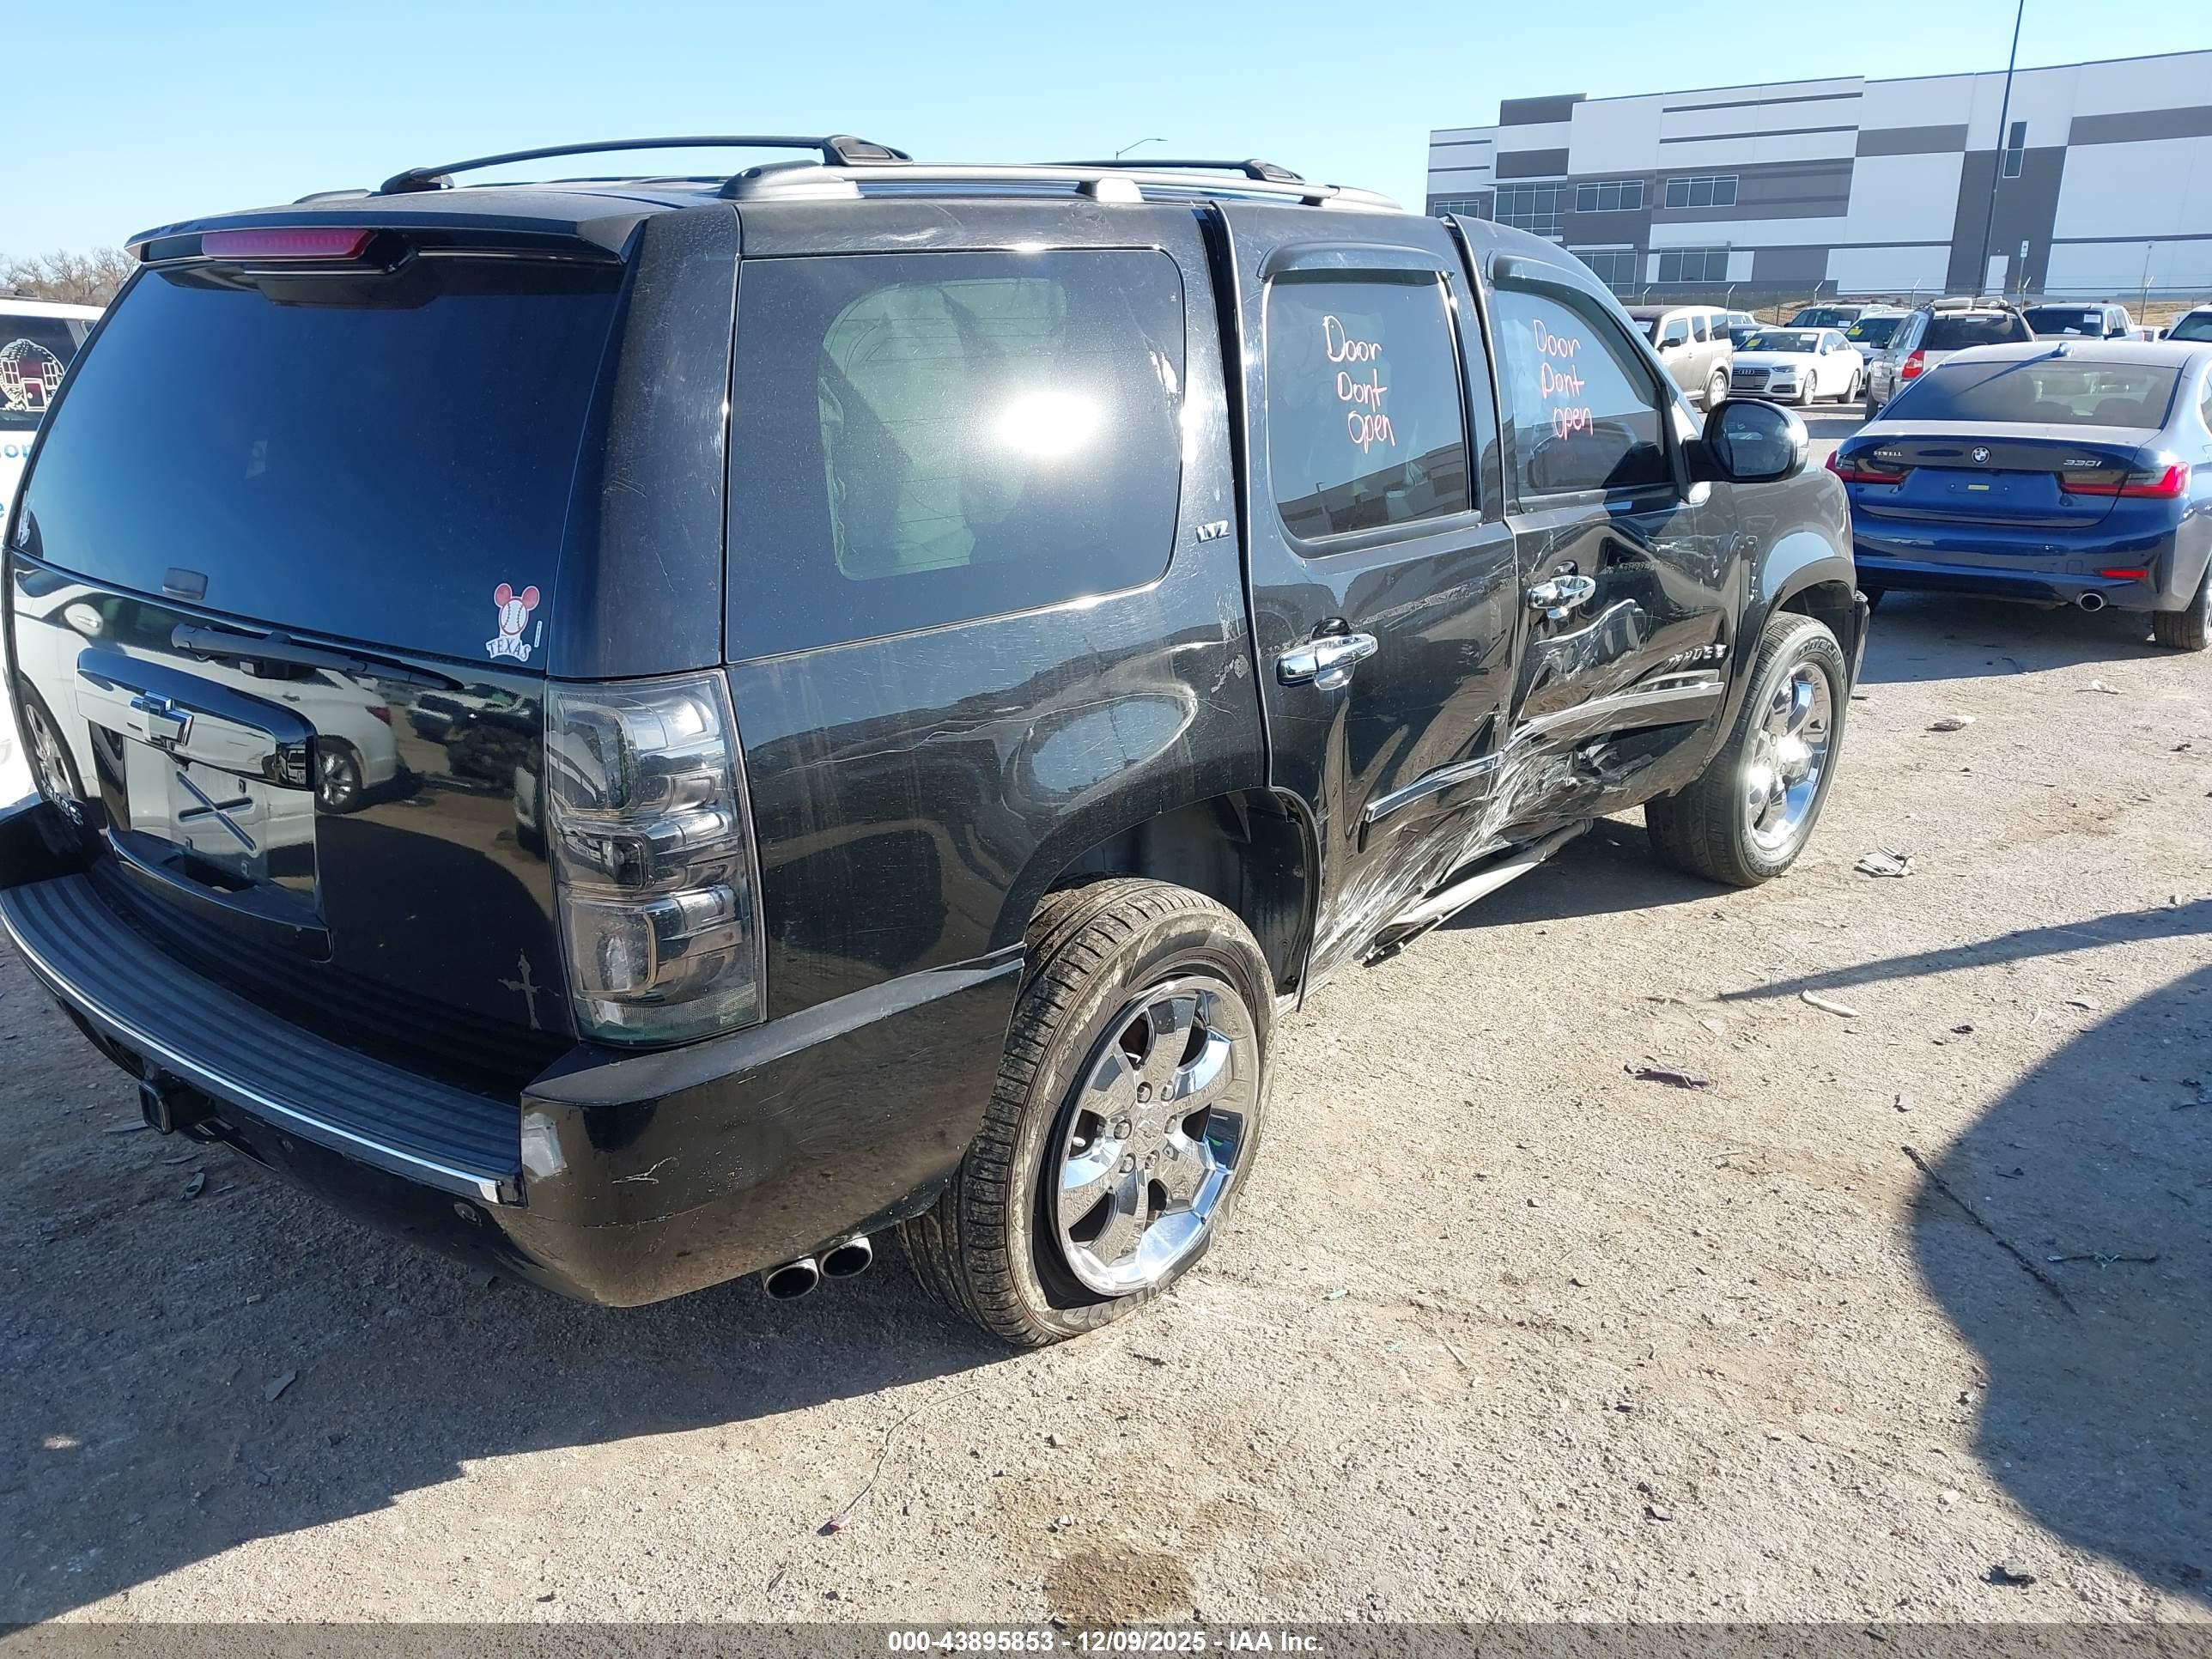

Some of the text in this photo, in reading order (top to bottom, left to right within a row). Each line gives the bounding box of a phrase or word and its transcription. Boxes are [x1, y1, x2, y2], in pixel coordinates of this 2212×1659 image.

[1322, 314, 1382, 362] Door
[1533, 319, 1581, 358] Door
[1337, 368, 1388, 412] Dont
[1541, 362, 1585, 399] Dont
[1347, 410, 1396, 453] Open
[1195, 520, 1230, 542] LTZ
[487, 637, 530, 660] TEXAS
